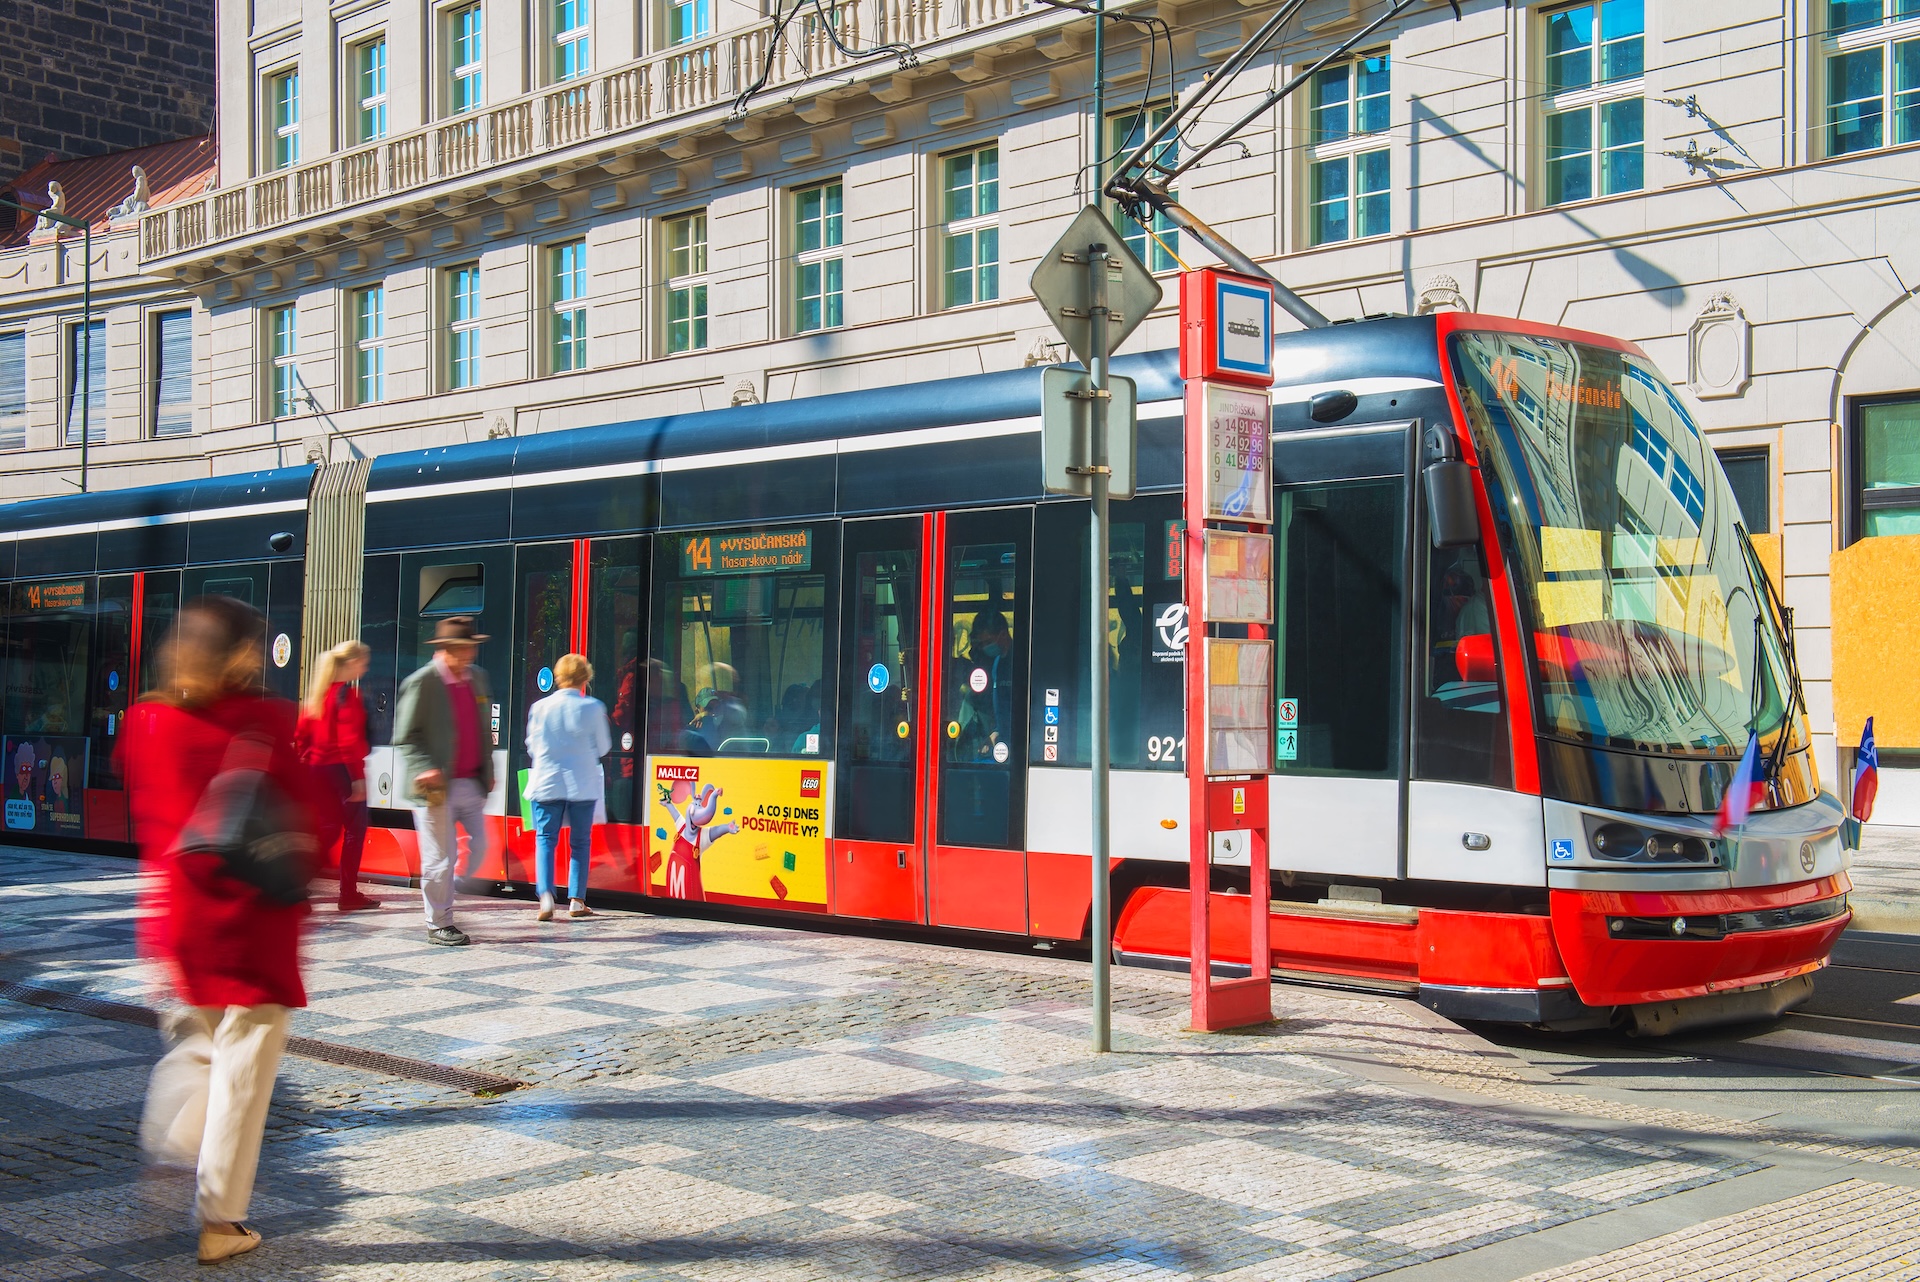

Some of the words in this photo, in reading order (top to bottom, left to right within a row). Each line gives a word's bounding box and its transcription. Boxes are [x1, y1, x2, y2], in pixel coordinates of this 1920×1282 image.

[1490, 356, 1519, 400] 14
[1219, 402, 1256, 417] JINDŘIŠSKÁ
[1214, 417, 1220, 430] 3
[1225, 418, 1237, 432] 14
[1239, 420, 1250, 434] 91
[1251, 421, 1263, 436] 95
[1214, 434, 1220, 448] 5
[1225, 435, 1237, 450] 24
[1239, 437, 1250, 452] 92
[1251, 439, 1263, 454] 96
[1214, 451, 1221, 466] 6
[1225, 453, 1237, 467] 41
[1239, 455, 1250, 469] 94
[1251, 456, 1263, 471] 98
[1214, 469, 1221, 483] 9
[686, 538, 712, 570] 14
[728, 530, 807, 551] VYSOČANSKÁ
[721, 553, 778, 569] Masarykovo
[781, 550, 806, 566] nádr.
[27, 585, 41, 609] 14
[657, 767, 698, 780] MALL.CZ
[802, 778, 819, 789] LEGO
[757, 804, 764, 816] A
[767, 805, 780, 817] CO
[783, 806, 791, 819] SI
[794, 807, 819, 820] DNES
[742, 816, 799, 836] POSTAVÍTE
[801, 825, 819, 838] VY?
[669, 860, 686, 900] M
